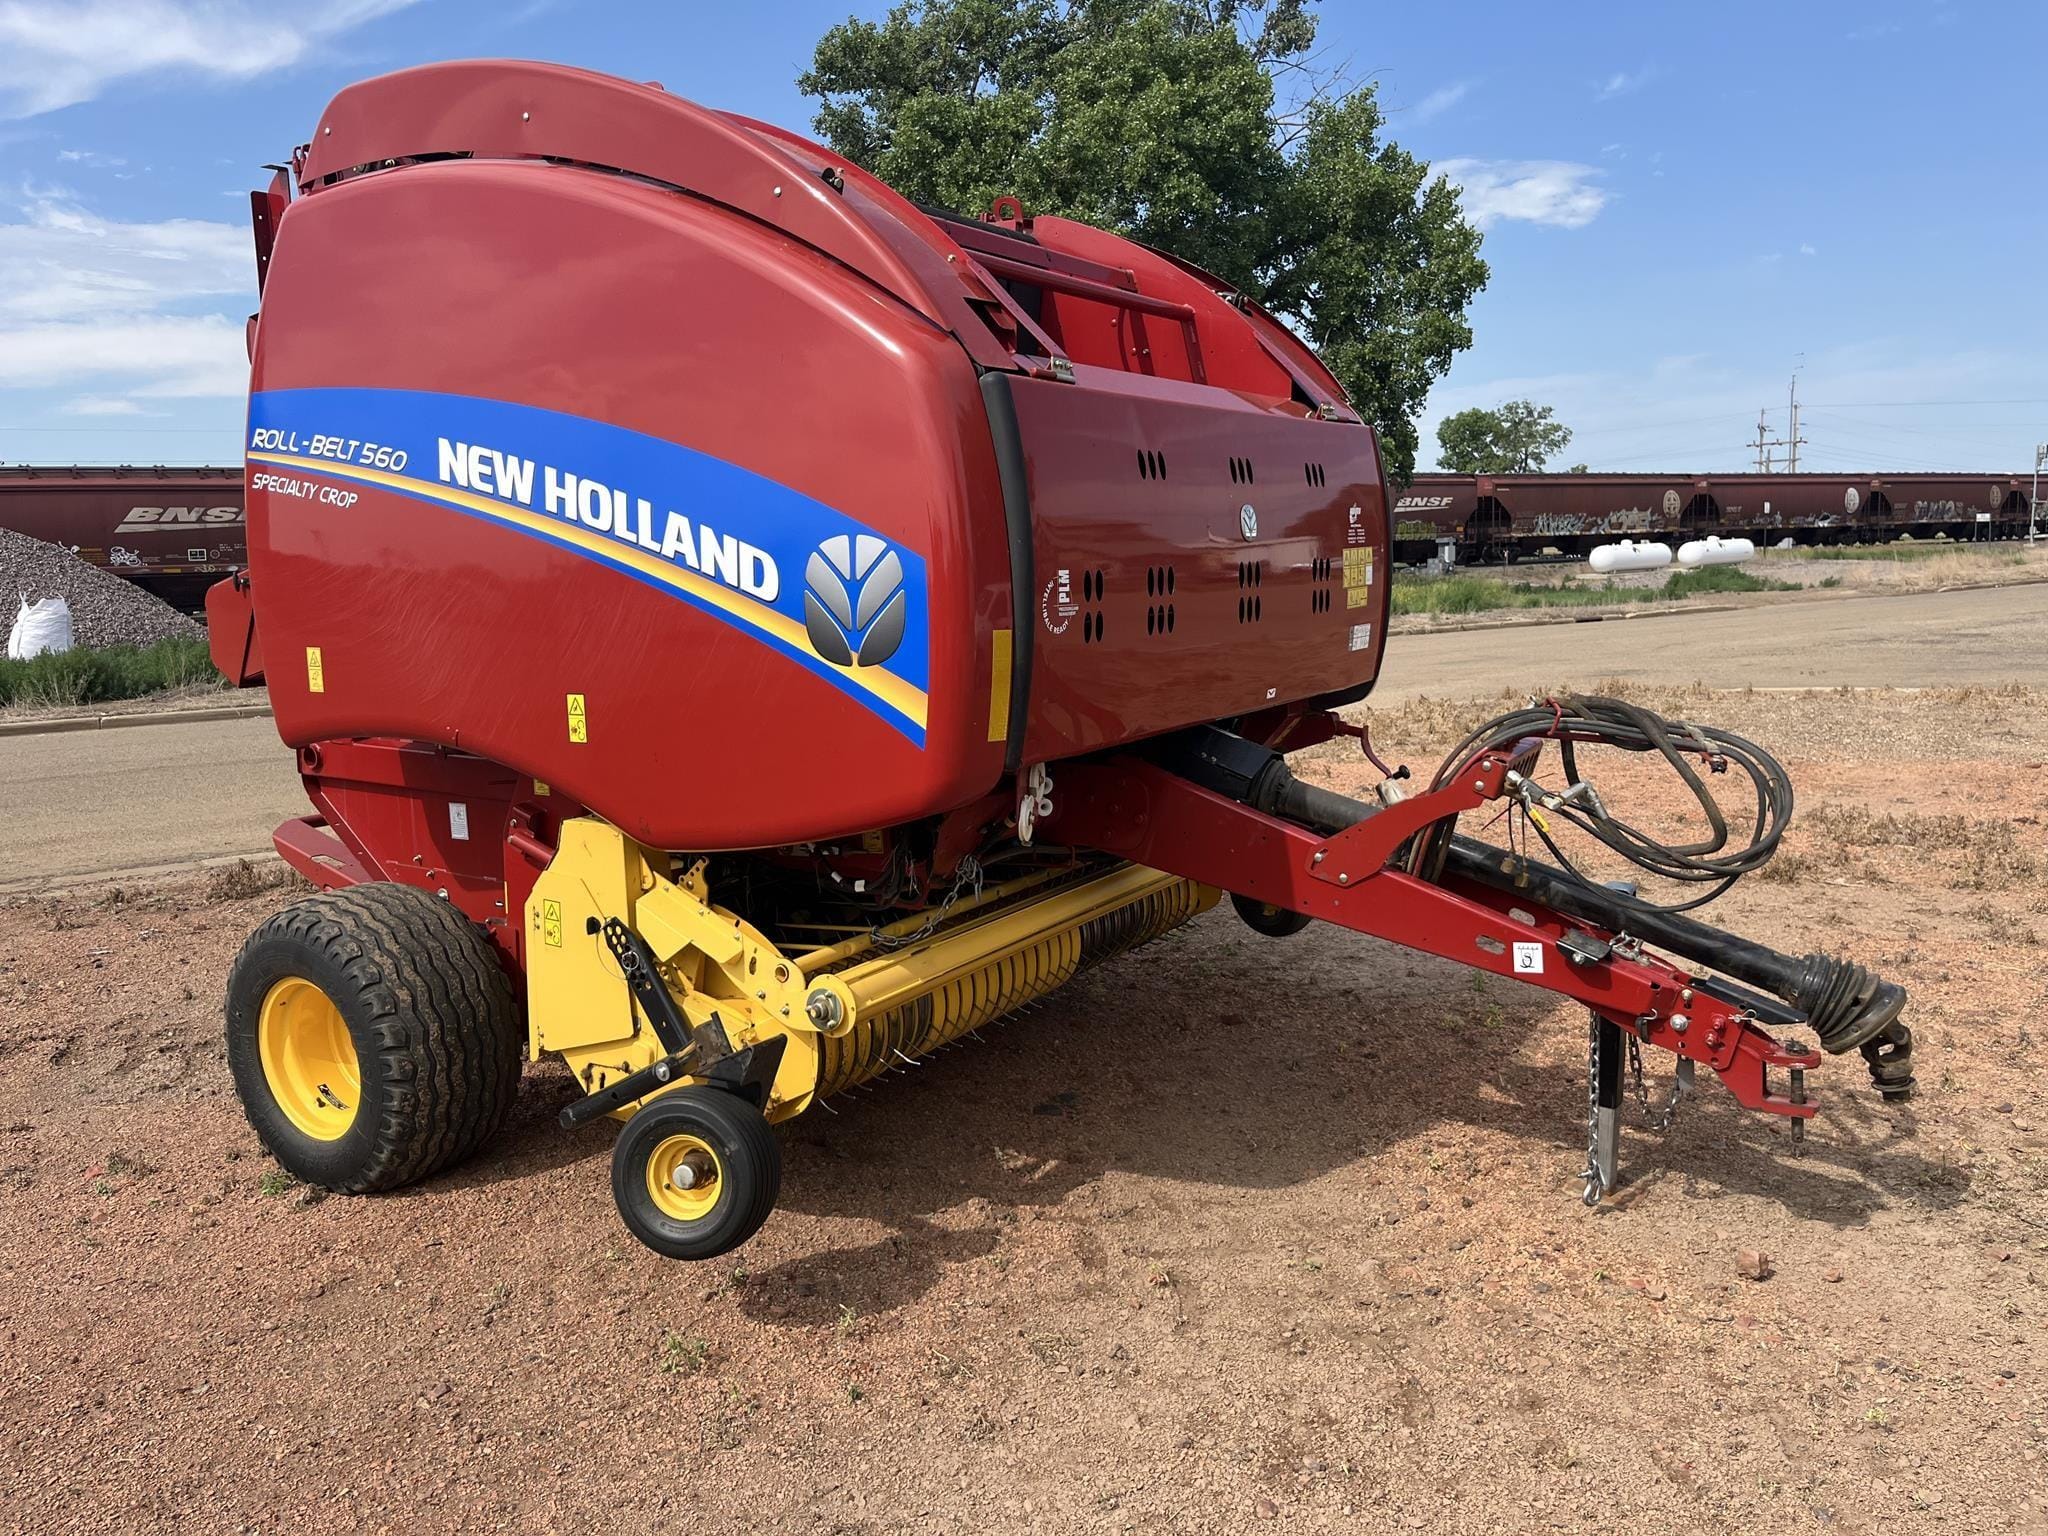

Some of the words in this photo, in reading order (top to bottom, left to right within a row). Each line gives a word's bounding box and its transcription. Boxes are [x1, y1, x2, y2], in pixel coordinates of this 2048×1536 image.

[252, 428, 360, 461] ROLL-BELT
[359, 443, 408, 472] 560
[251, 473, 319, 500] SPECIALTY
[319, 486, 359, 509] CROP
[1396, 496, 1454, 507] BNSF
[437, 436, 536, 507] NEW
[544, 465, 780, 604] HOLLAND
[1058, 569, 1070, 604] PLM
[1053, 618, 1069, 634] READY
